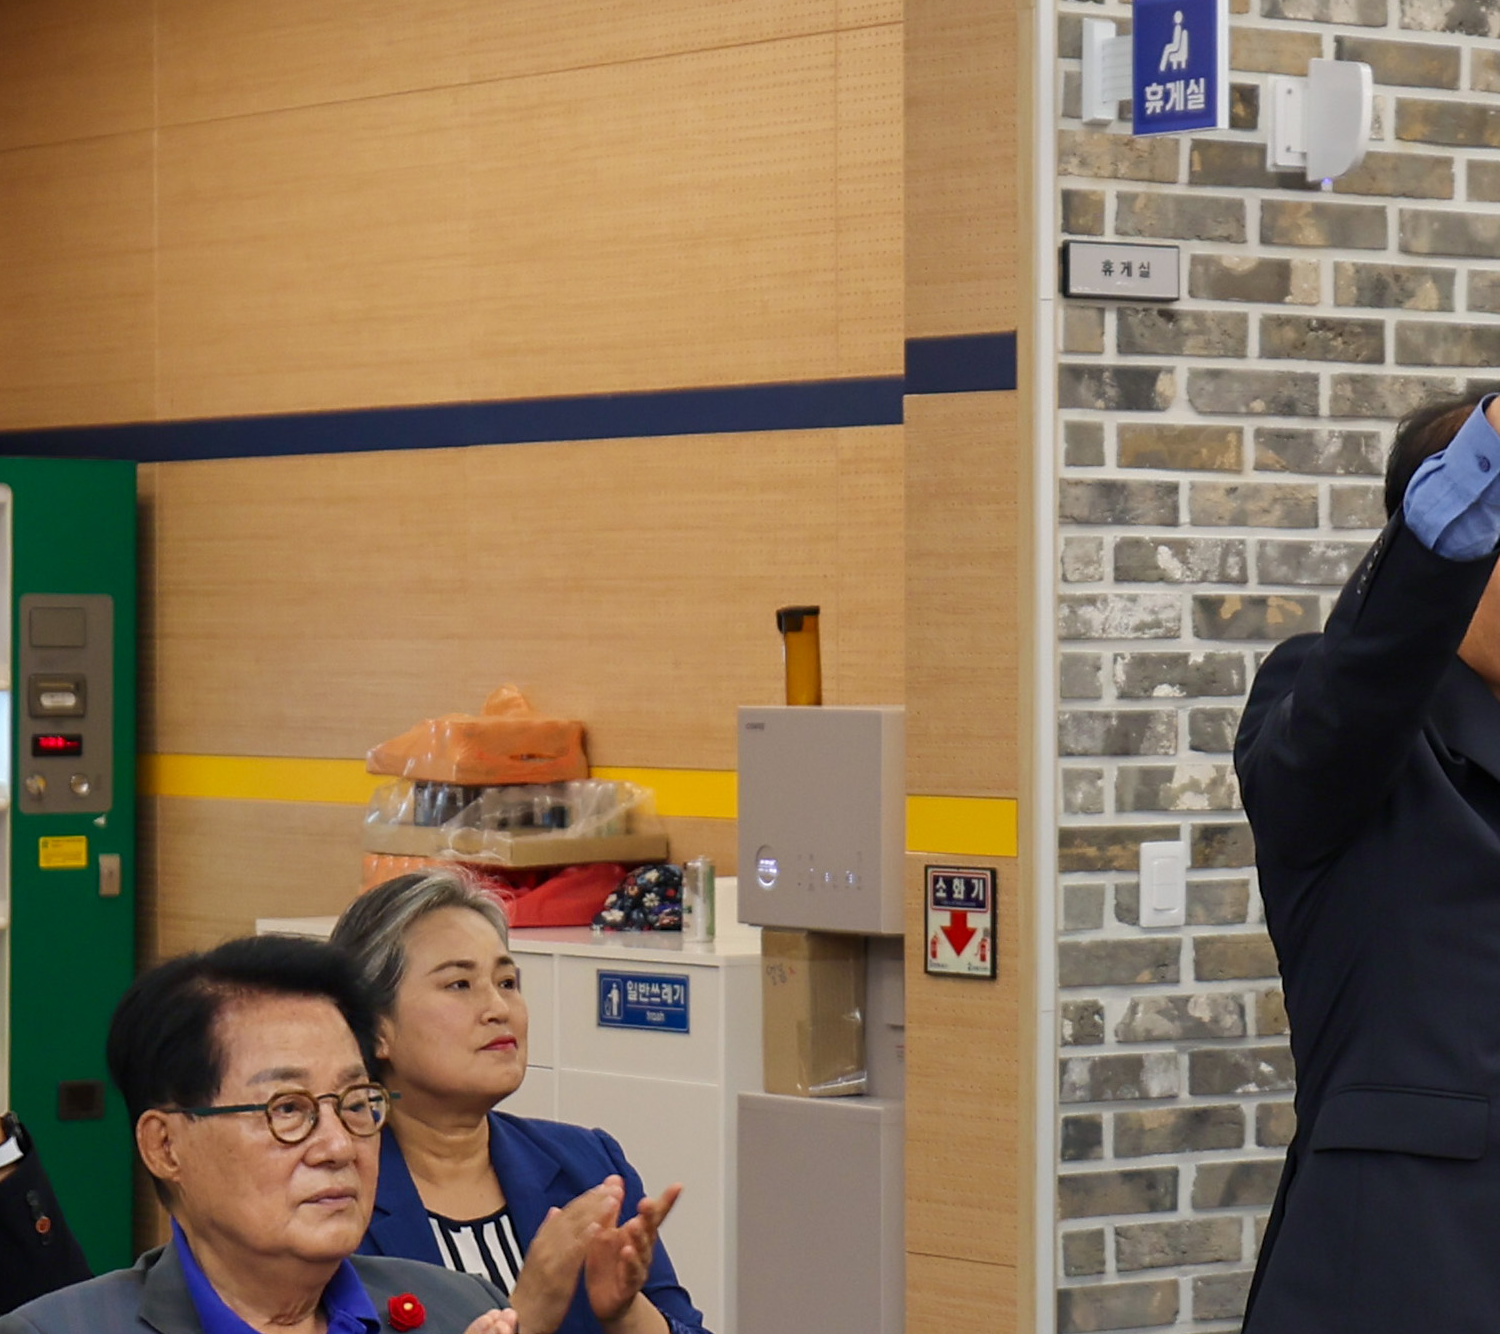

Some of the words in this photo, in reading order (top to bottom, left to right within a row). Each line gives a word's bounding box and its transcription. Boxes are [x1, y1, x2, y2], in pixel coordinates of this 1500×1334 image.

[1145, 78, 1206, 114] 휴게실
[1101, 259, 1151, 278] 휴게실
[935, 876, 984, 901] 소화기
[626, 980, 685, 1005] 일반쓰레기
